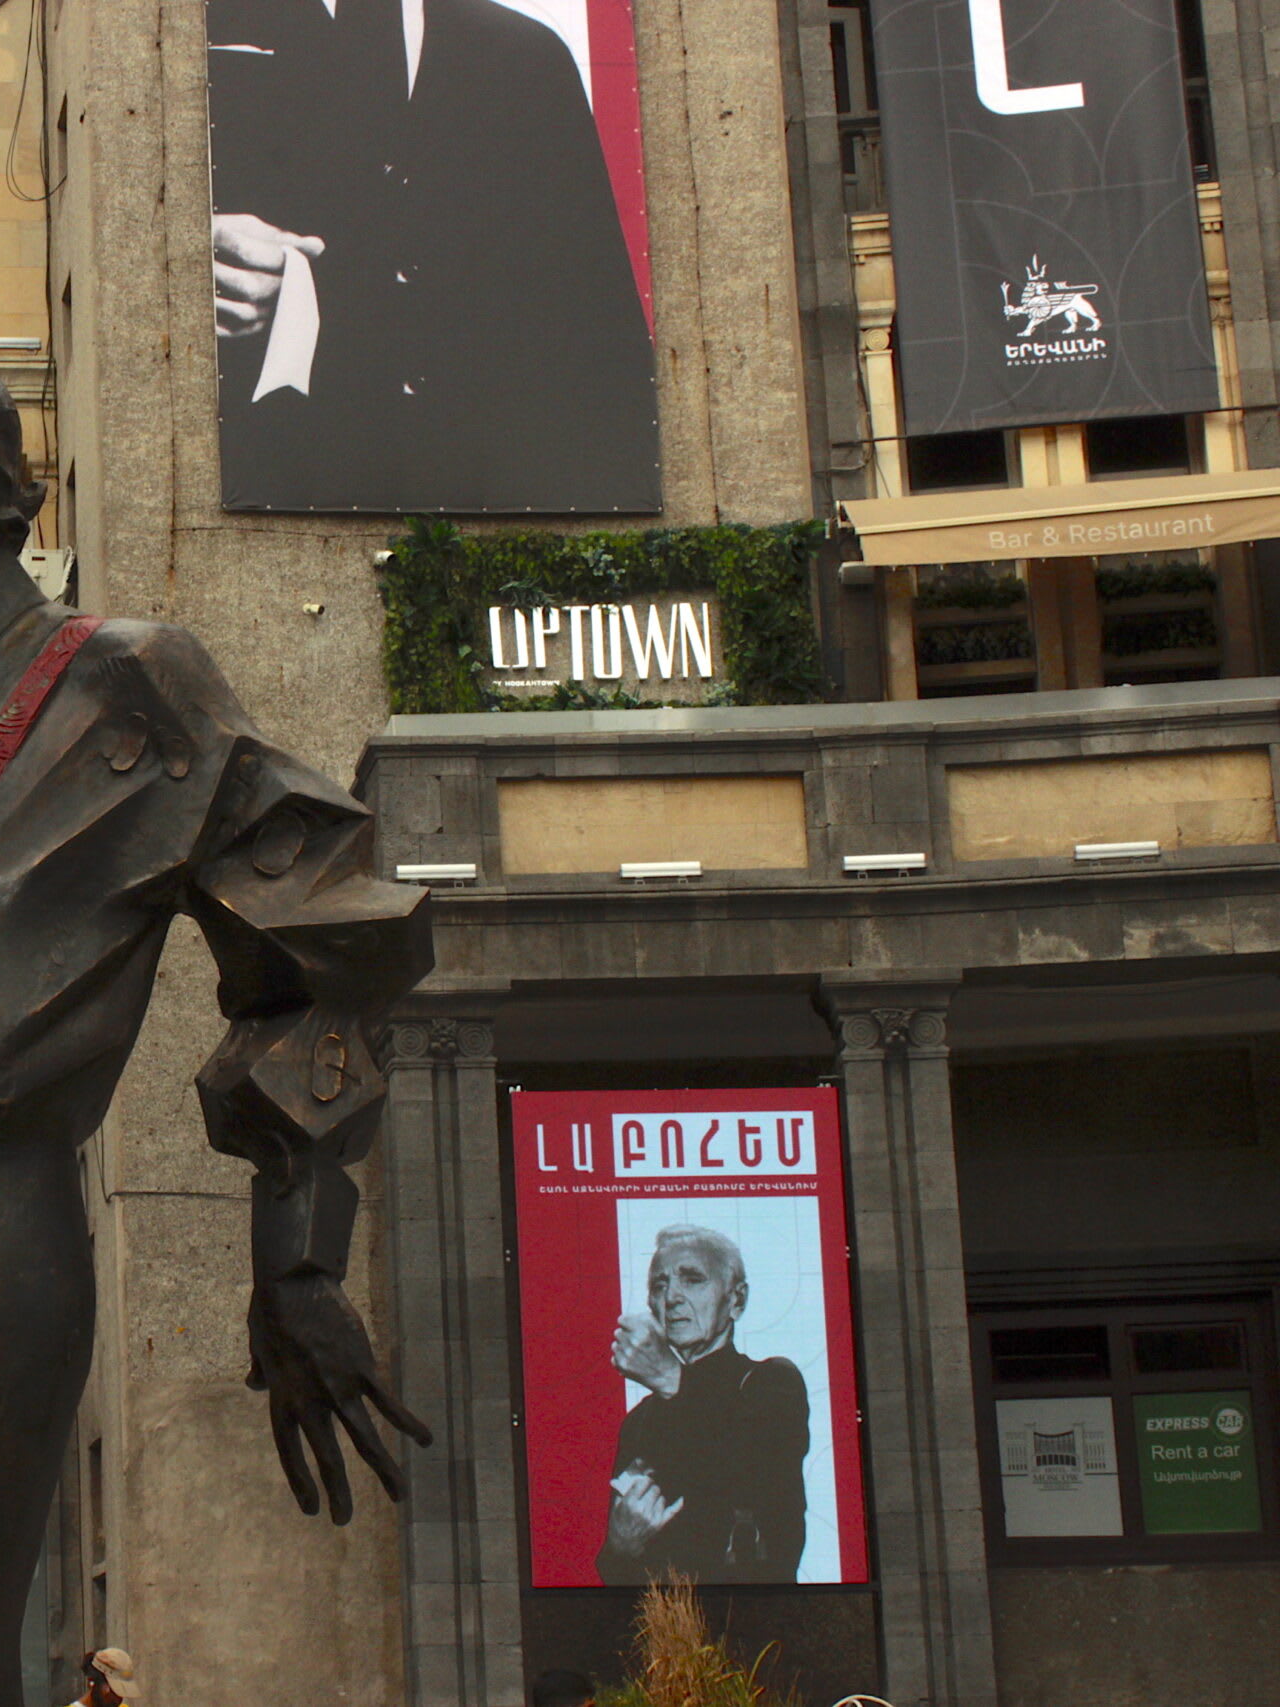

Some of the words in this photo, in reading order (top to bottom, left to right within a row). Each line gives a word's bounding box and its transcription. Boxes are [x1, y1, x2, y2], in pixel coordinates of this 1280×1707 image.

[1005, 338, 1107, 359] ԵՐԵՎԱՆԻ
[988, 530, 1033, 550] Bar
[1043, 526, 1060, 547] &
[1068, 513, 1215, 545] Restaurant
[488, 601, 713, 682] UPTOWN
[536, 1123, 595, 1173] ԼԱ
[620, 1117, 805, 1169] ԲՈՀԵՄ
[1146, 1416, 1210, 1432] EXPRESS
[1151, 1444, 1193, 1461] Rent
[1198, 1447, 1209, 1459] a
[1213, 1444, 1241, 1458] car
